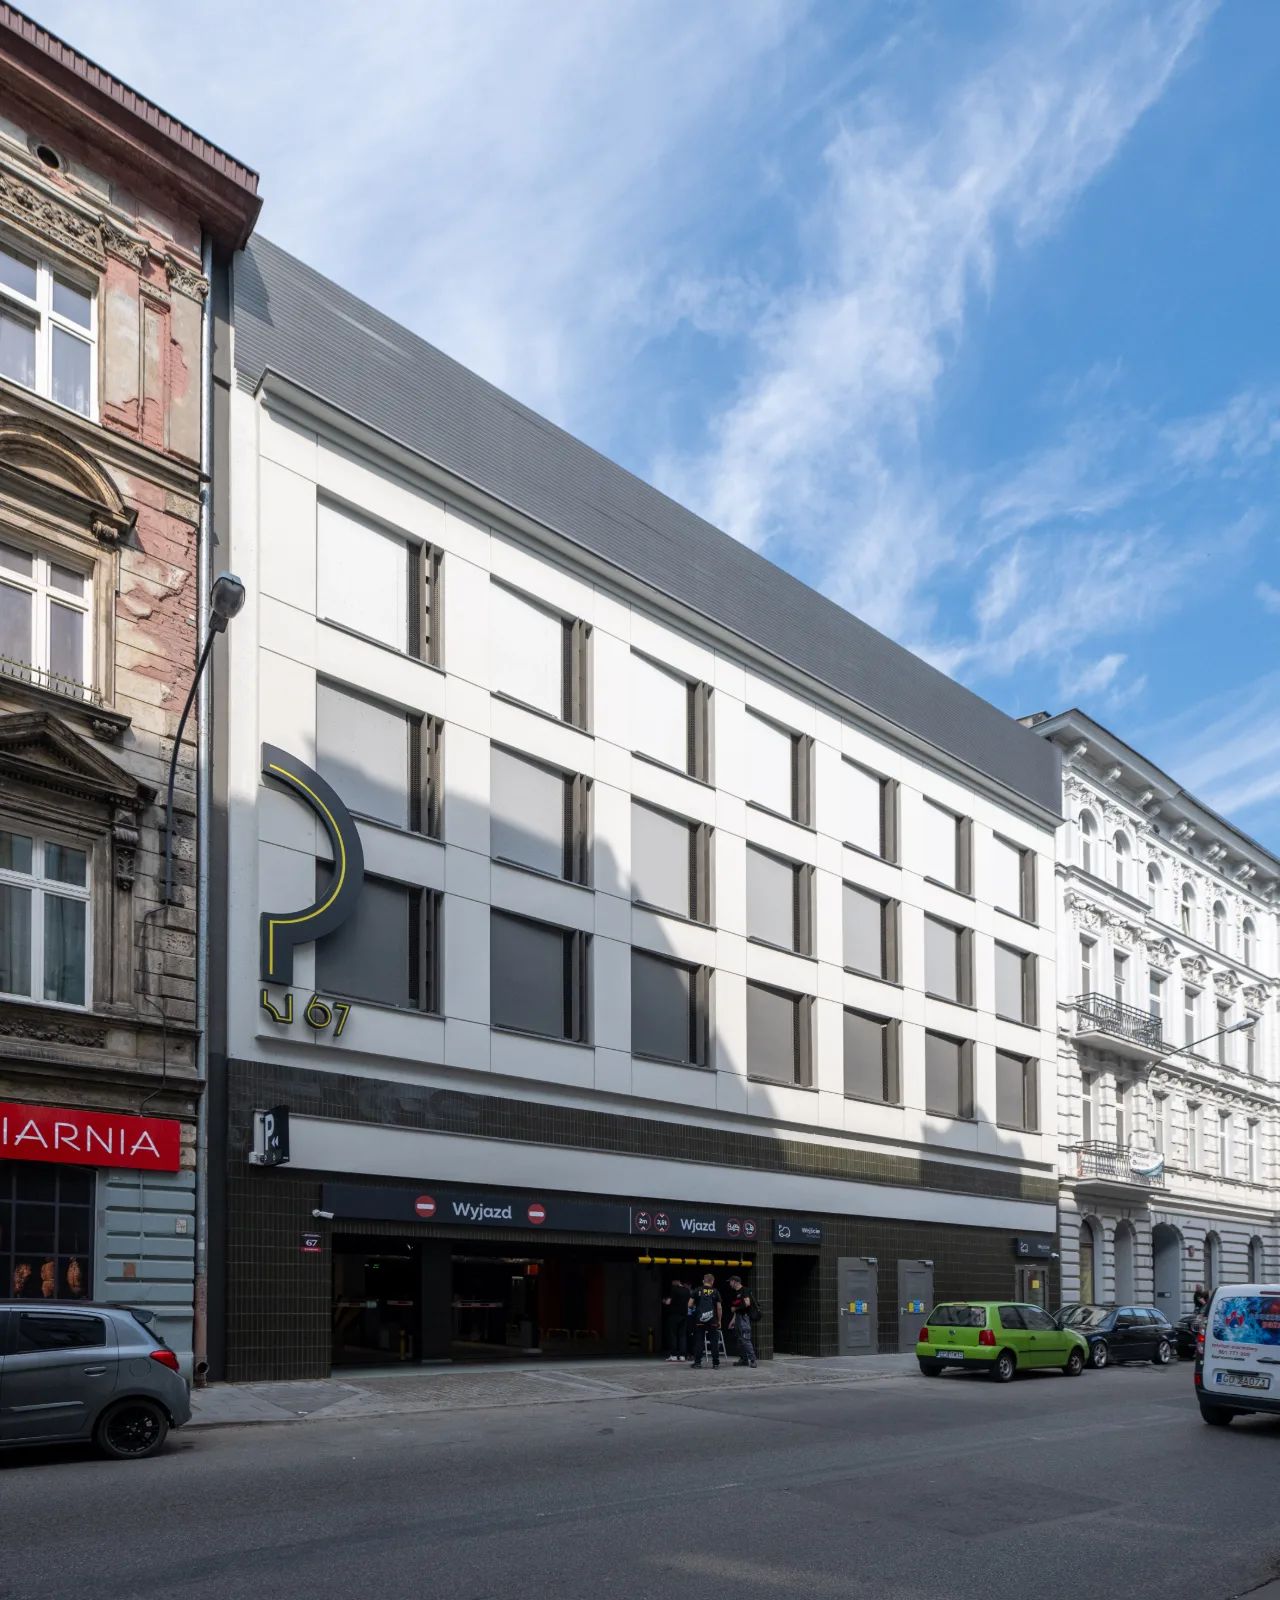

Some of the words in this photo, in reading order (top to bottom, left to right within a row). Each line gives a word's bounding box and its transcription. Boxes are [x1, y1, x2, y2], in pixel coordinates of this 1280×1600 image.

[304, 993, 352, 1037] 67
[3, 1117, 160, 1158] IARNIA
[264, 1113, 275, 1150] P
[452, 1201, 512, 1220] Wyjazd
[680, 1218, 716, 1233] Wjazd
[305, 1239, 318, 1247] 67
